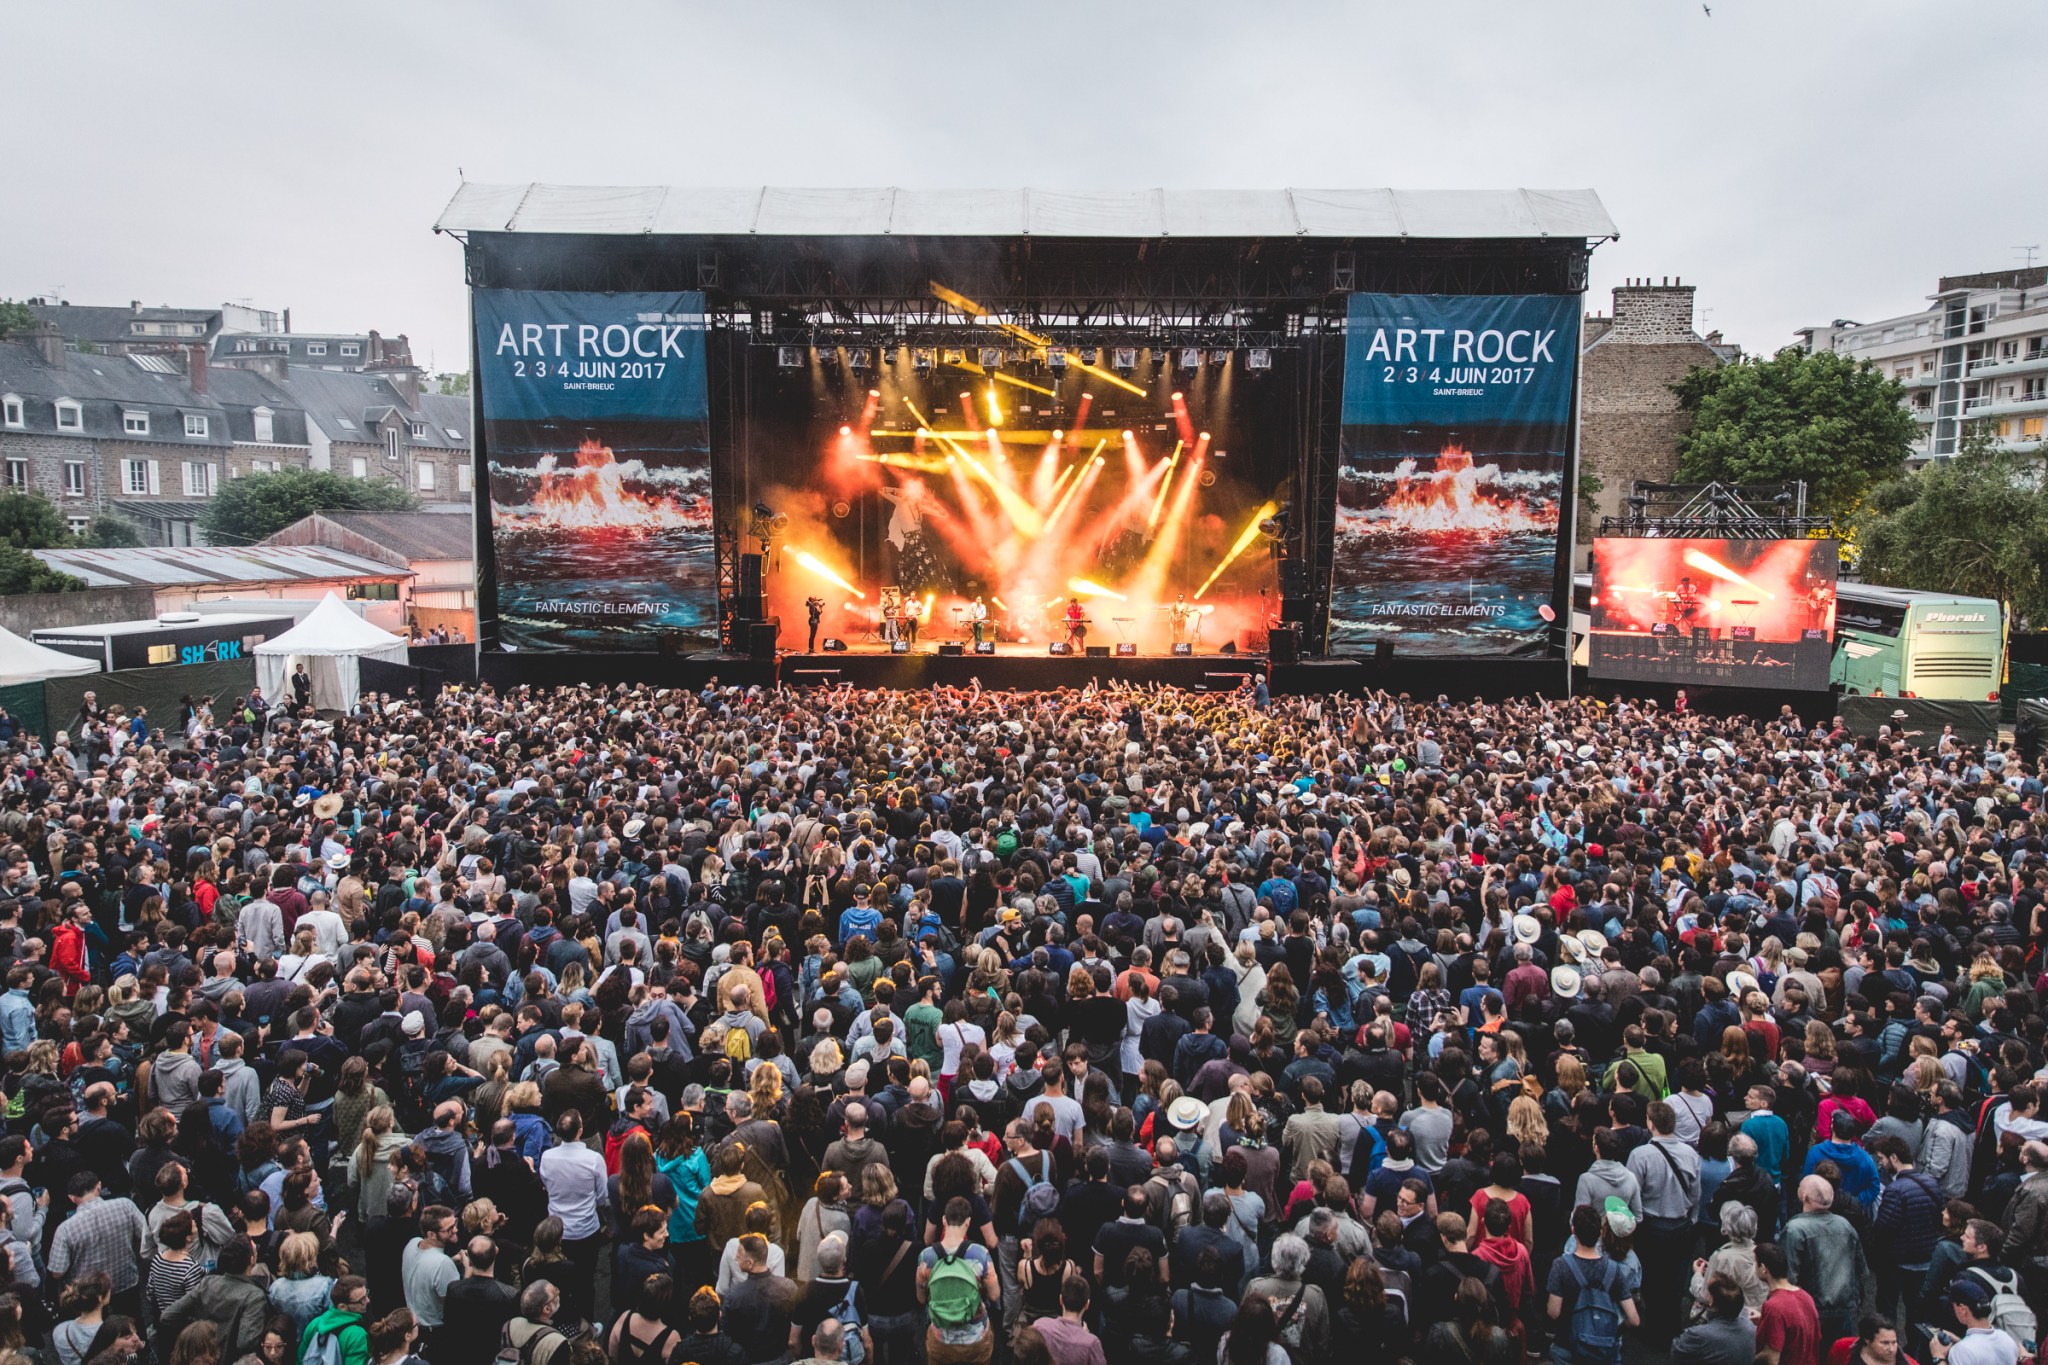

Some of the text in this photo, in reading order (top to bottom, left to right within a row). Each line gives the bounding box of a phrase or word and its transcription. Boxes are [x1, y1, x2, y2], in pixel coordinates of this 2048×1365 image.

[496, 323, 685, 359] ART ROCK
[1365, 328, 1556, 363] ART ROCK
[514, 361, 526, 377] 2
[535, 361, 547, 377] 3
[557, 362, 569, 378] 4
[573, 362, 616, 379] JUIN
[620, 362, 666, 379] 2017
[1383, 366, 1395, 382] 2
[1406, 366, 1418, 383] 3
[1429, 367, 1441, 383] 4
[1444, 367, 1487, 384] JUIN
[1490, 367, 1535, 384] 2017
[563, 382, 615, 390] SAINT-BRIEUC
[1433, 388, 1484, 396] SAINT-BRIEUC
[535, 601, 670, 614] FANTASTIC ELEMENTS
[1372, 604, 1505, 616] FANTASTIC ELEMENTS
[1925, 612, 1987, 622] Phoenix
[181, 639, 240, 665] SHARK
